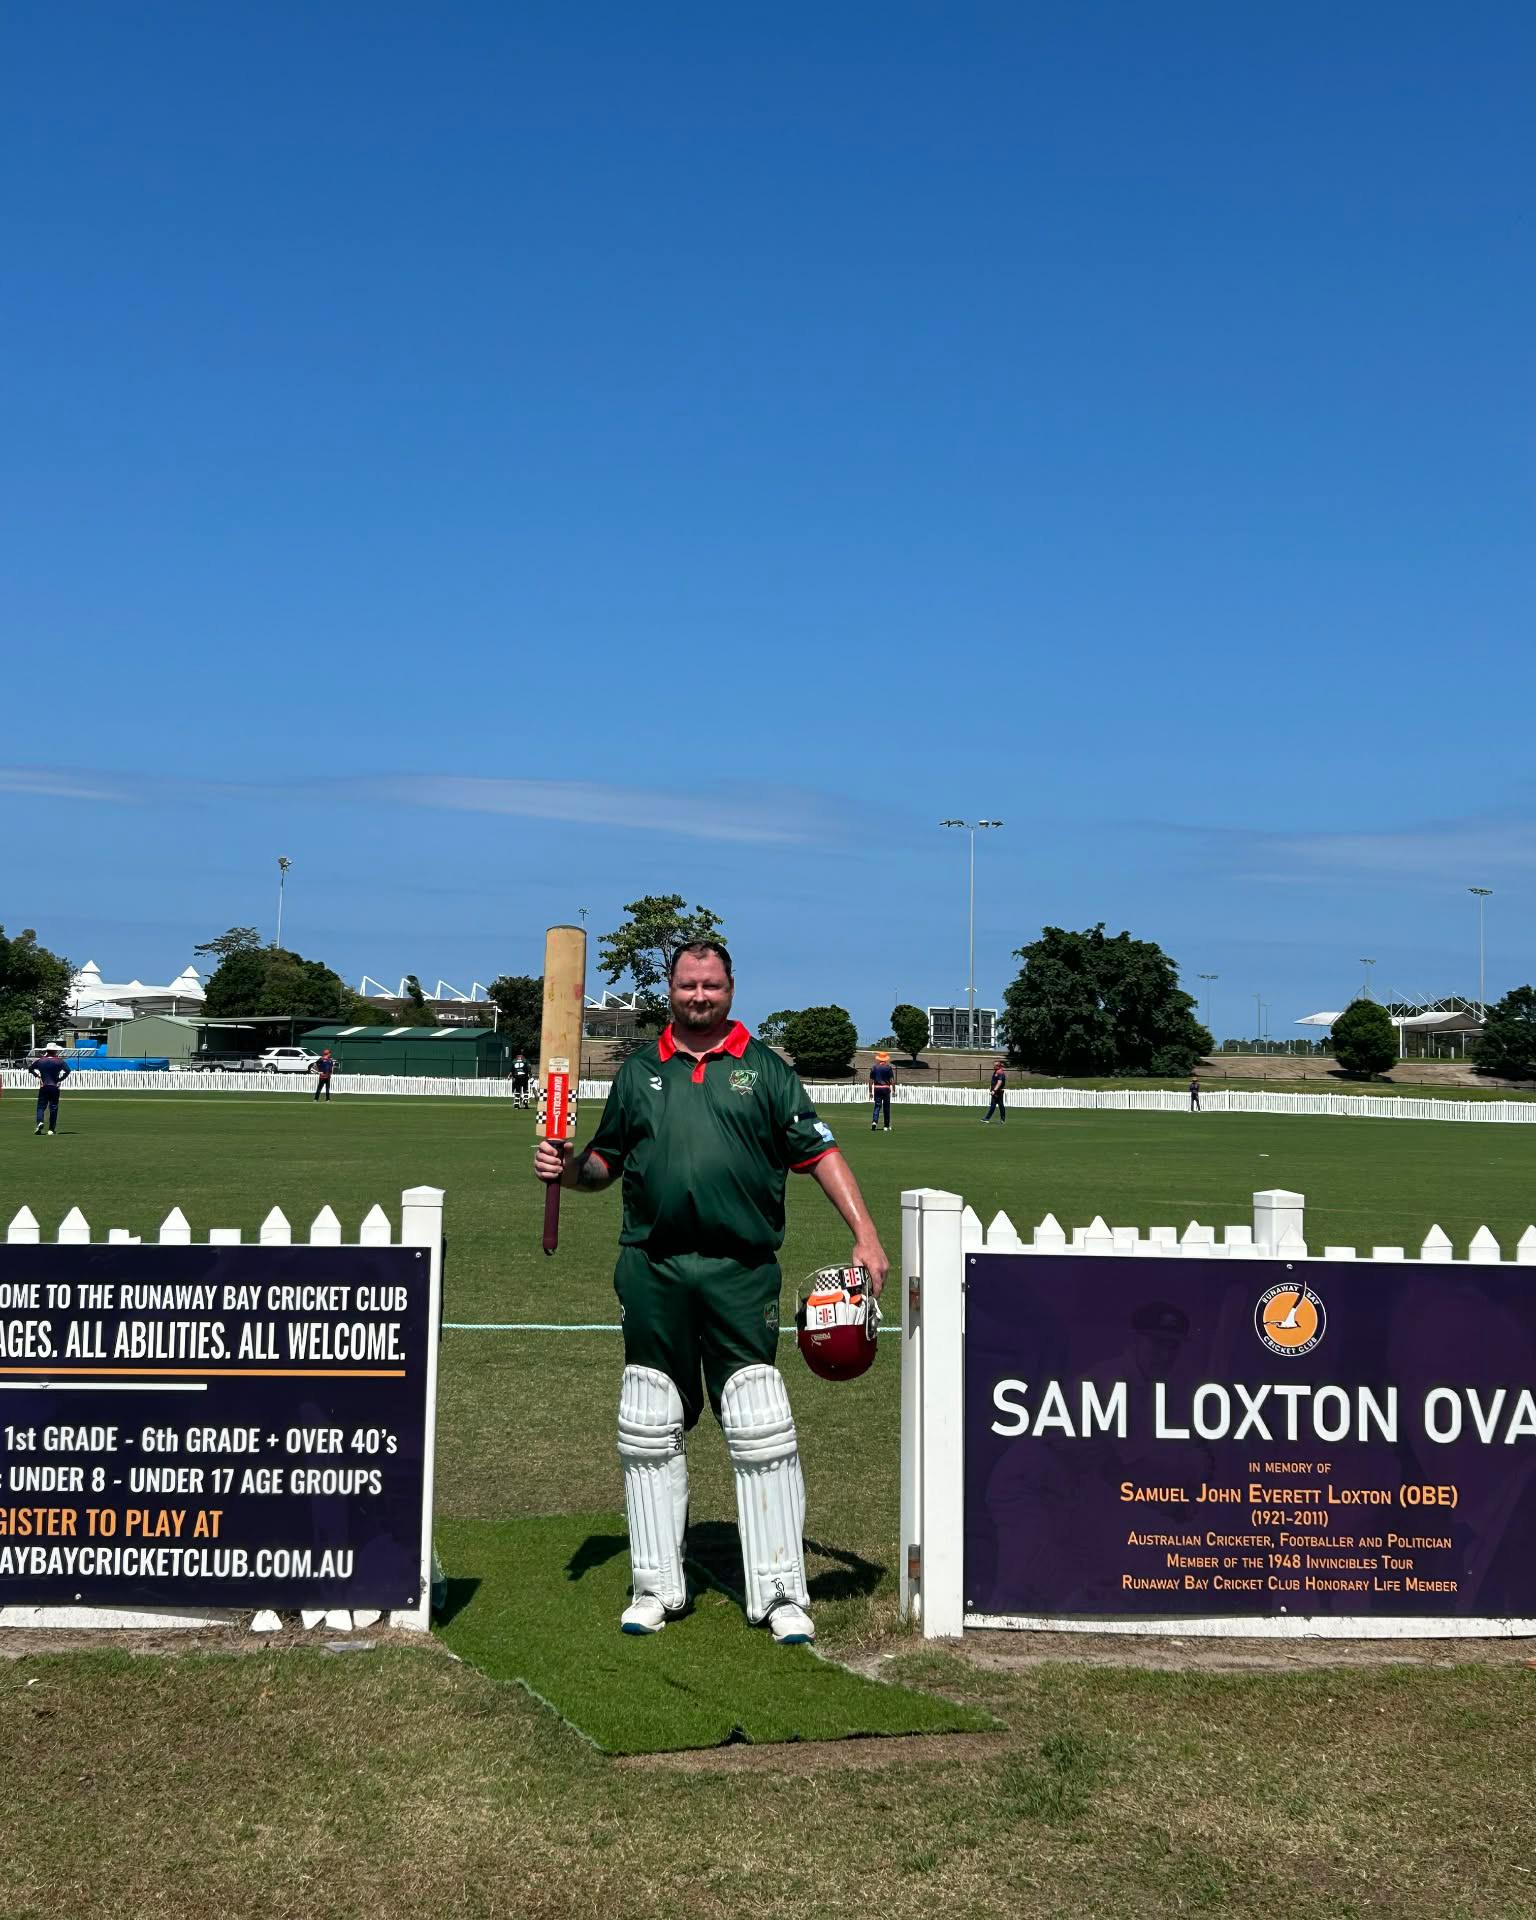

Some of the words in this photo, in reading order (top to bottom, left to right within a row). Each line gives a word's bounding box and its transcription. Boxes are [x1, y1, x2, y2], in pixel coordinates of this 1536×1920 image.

[45, 1283, 71, 1310] TO
[76, 1284, 115, 1310] THE
[119, 1284, 218, 1310] RUNAWAY
[222, 1285, 263, 1311] BAY
[267, 1285, 351, 1311] CRICKET
[356, 1285, 408, 1312] CLUB
[1261, 1285, 1300, 1304] RUNAWAY
[1305, 1291, 1320, 1305] BAY
[64, 1320, 108, 1359] ALL
[113, 1320, 231, 1360] ABILITIES.
[238, 1321, 280, 1360] ALL
[287, 1322, 406, 1361] WELCOME.
[1263, 1335, 1297, 1355] CRICKET
[1298, 1336, 1317, 1353] CLUB
[990, 1379, 1127, 1439] SAM
[1155, 1382, 1398, 1443] LOXTON
[1424, 1387, 1536, 1445] OVA
[4, 1425, 37, 1451] 1st
[43, 1425, 119, 1452] GRADE
[141, 1426, 179, 1453] 6th
[185, 1427, 261, 1453] GRADE
[267, 1434, 279, 1447] +
[285, 1427, 344, 1454] OVER
[350, 1428, 398, 1455] 40's
[9, 1466, 84, 1492] UNDER
[91, 1466, 106, 1493] 8
[129, 1467, 205, 1494] UNDER
[211, 1468, 235, 1494] 17
[239, 1468, 284, 1495] AGE
[290, 1468, 382, 1495] GROUPS
[1248, 1462, 1261, 1473] IN
[1265, 1462, 1313, 1474] MEMORY
[1316, 1462, 1332, 1474] OF
[1120, 1481, 1190, 1503] SAMUEL
[1195, 1482, 1241, 1503] JOHN
[1248, 1483, 1322, 1504] EVERETT
[1328, 1484, 1392, 1505] LOXTON
[1399, 1484, 1458, 1509] (OBE)
[85, 1508, 117, 1537] TO
[125, 1509, 187, 1538] PLAY
[193, 1510, 224, 1538] AT
[1251, 1509, 1329, 1528] (1921-2011)
[1127, 1530, 1201, 1546] AUSTRALIAN
[1206, 1531, 1275, 1549] CRICKETER,
[1279, 1532, 1354, 1548] FOOTBALLER
[1358, 1537, 1383, 1548] AND
[1387, 1533, 1452, 1549] POLITICIAN
[0, 1546, 354, 1579] AYBAYCRICKETCLUB.COM.AU
[1166, 1552, 1219, 1568] MEMBER
[1223, 1557, 1239, 1569] OF
[1241, 1557, 1264, 1569] THE
[1268, 1553, 1301, 1569] 1948
[1306, 1554, 1378, 1570] INVINCIBLES
[1381, 1554, 1414, 1570] TOUR
[1122, 1574, 1180, 1590] RUNAWAY
[1184, 1574, 1209, 1591] BAY
[1213, 1575, 1264, 1590] CRICKET
[1267, 1575, 1301, 1591] CLUB
[1305, 1575, 1370, 1591] HONORARY
[1374, 1576, 1401, 1592] LIFE
[1405, 1576, 1458, 1592] MEMBER
